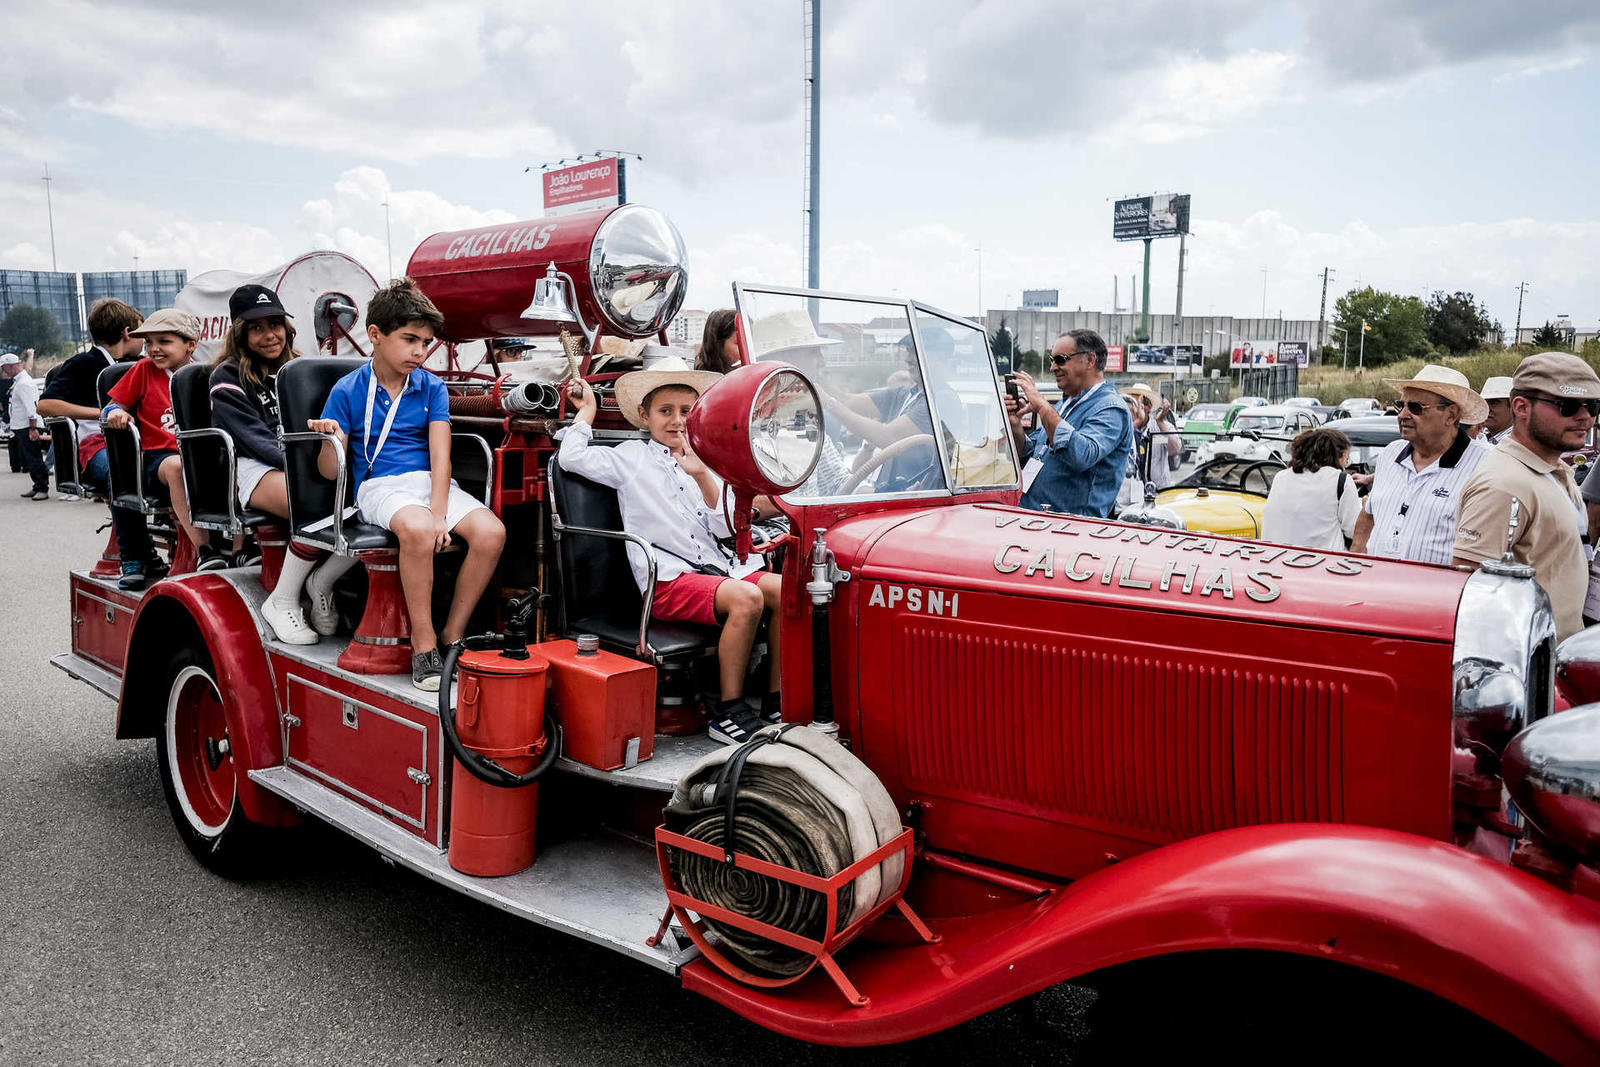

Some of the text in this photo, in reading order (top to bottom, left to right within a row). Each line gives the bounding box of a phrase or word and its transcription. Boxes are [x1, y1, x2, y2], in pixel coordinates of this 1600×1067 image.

[549, 165, 611, 188] João Lourenço
[444, 223, 558, 260] CACILHAS
[995, 515, 1373, 576] VOLUNTARIOS
[993, 543, 1283, 603] CACILHAS
[868, 584, 922, 611] APS
